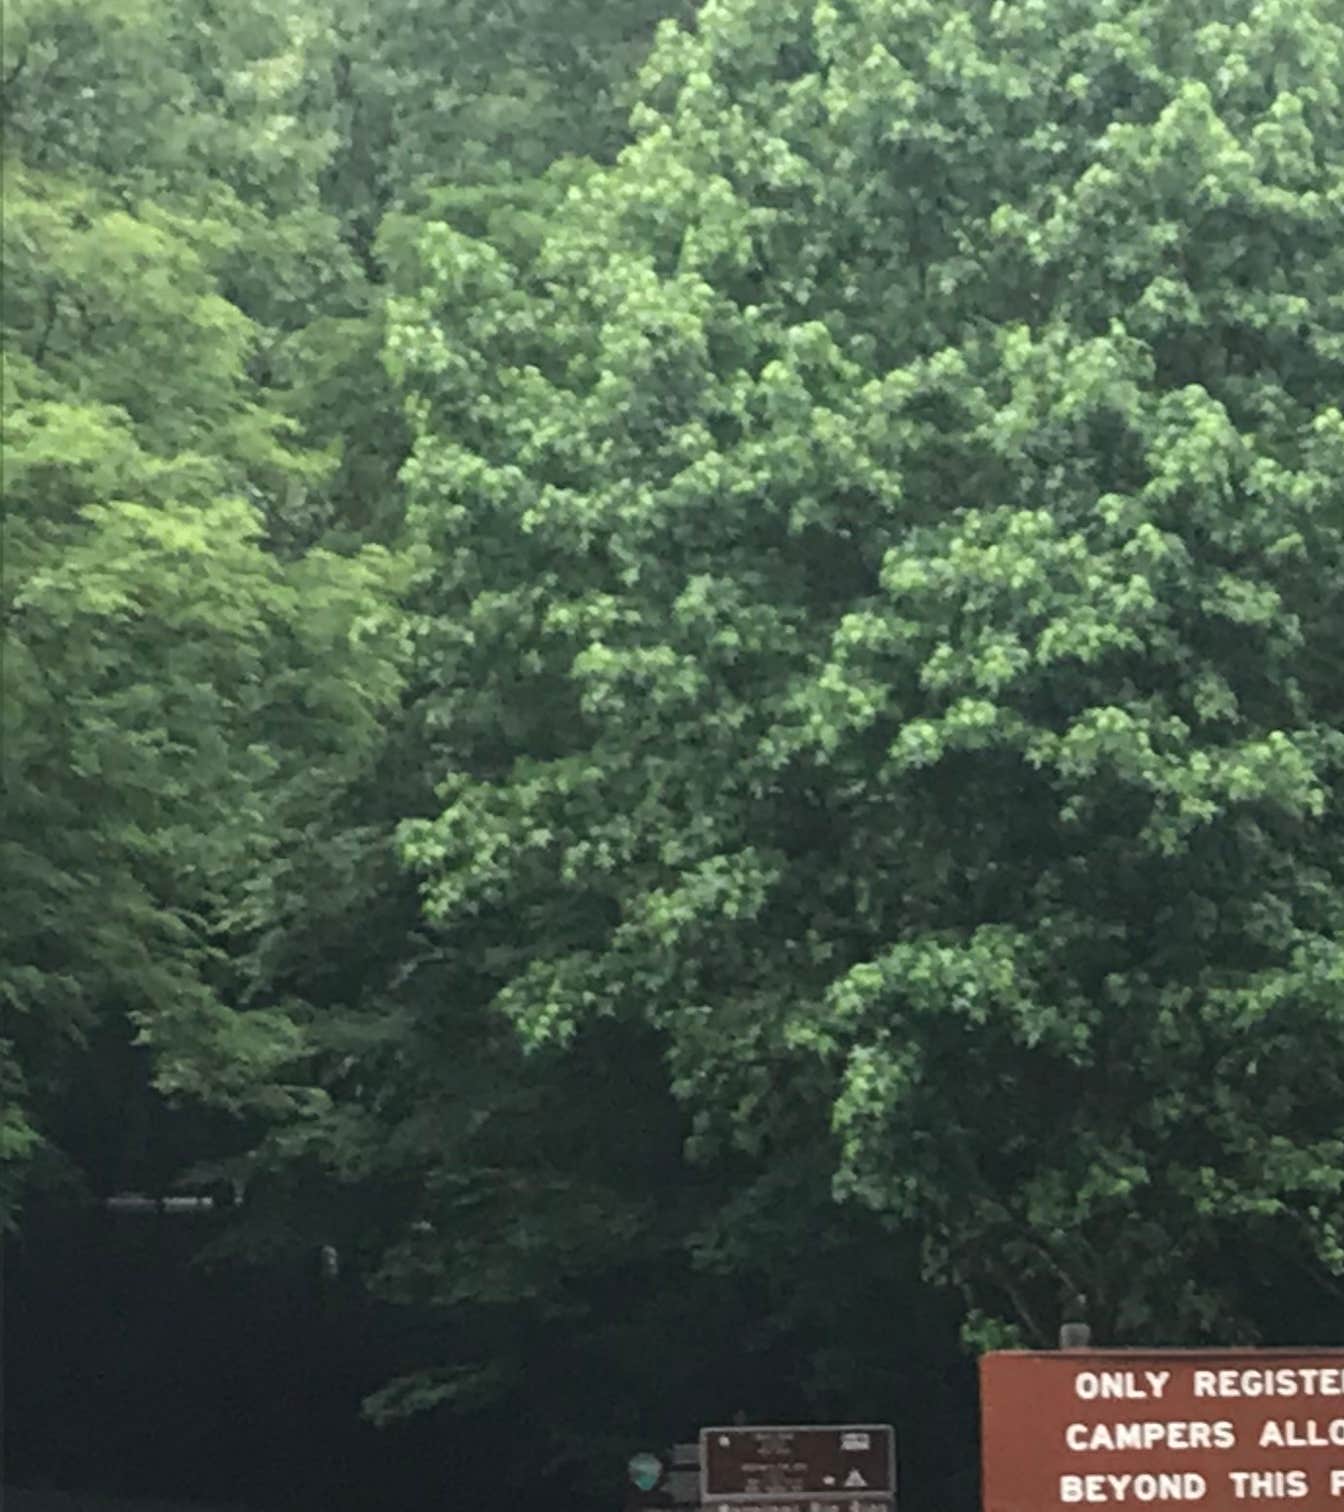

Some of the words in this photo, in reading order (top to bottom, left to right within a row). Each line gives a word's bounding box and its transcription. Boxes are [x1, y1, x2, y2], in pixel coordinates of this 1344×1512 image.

[1075, 1371, 1170, 1400] ONLY
[1065, 1420, 1236, 1452] CAMPERS
[1060, 1472, 1207, 1503] BEYOND
[1228, 1470, 1309, 1499] THIS
